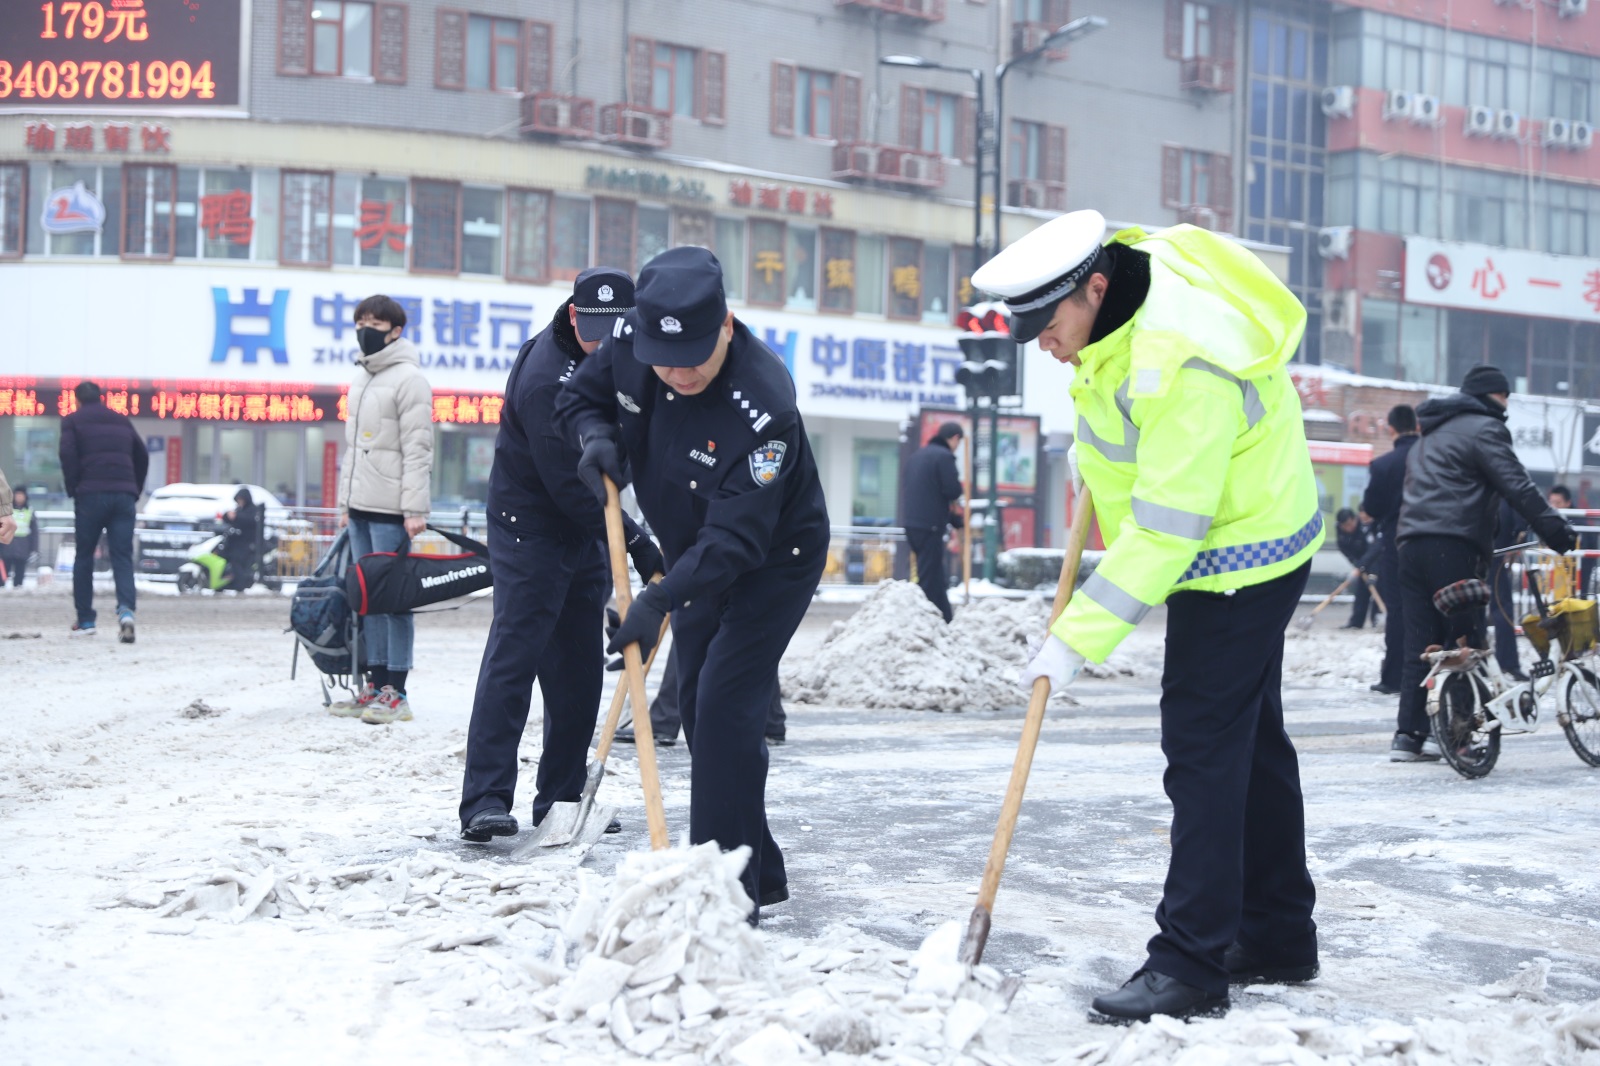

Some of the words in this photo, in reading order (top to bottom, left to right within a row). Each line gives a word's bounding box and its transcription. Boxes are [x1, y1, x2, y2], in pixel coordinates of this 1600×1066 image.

[41, 0, 148, 42] 179元
[313, 348, 467, 370] ZHOUAN
[475, 355, 516, 371] BAN
[812, 335, 964, 385] 中原银行
[689, 449, 717, 467] 017092
